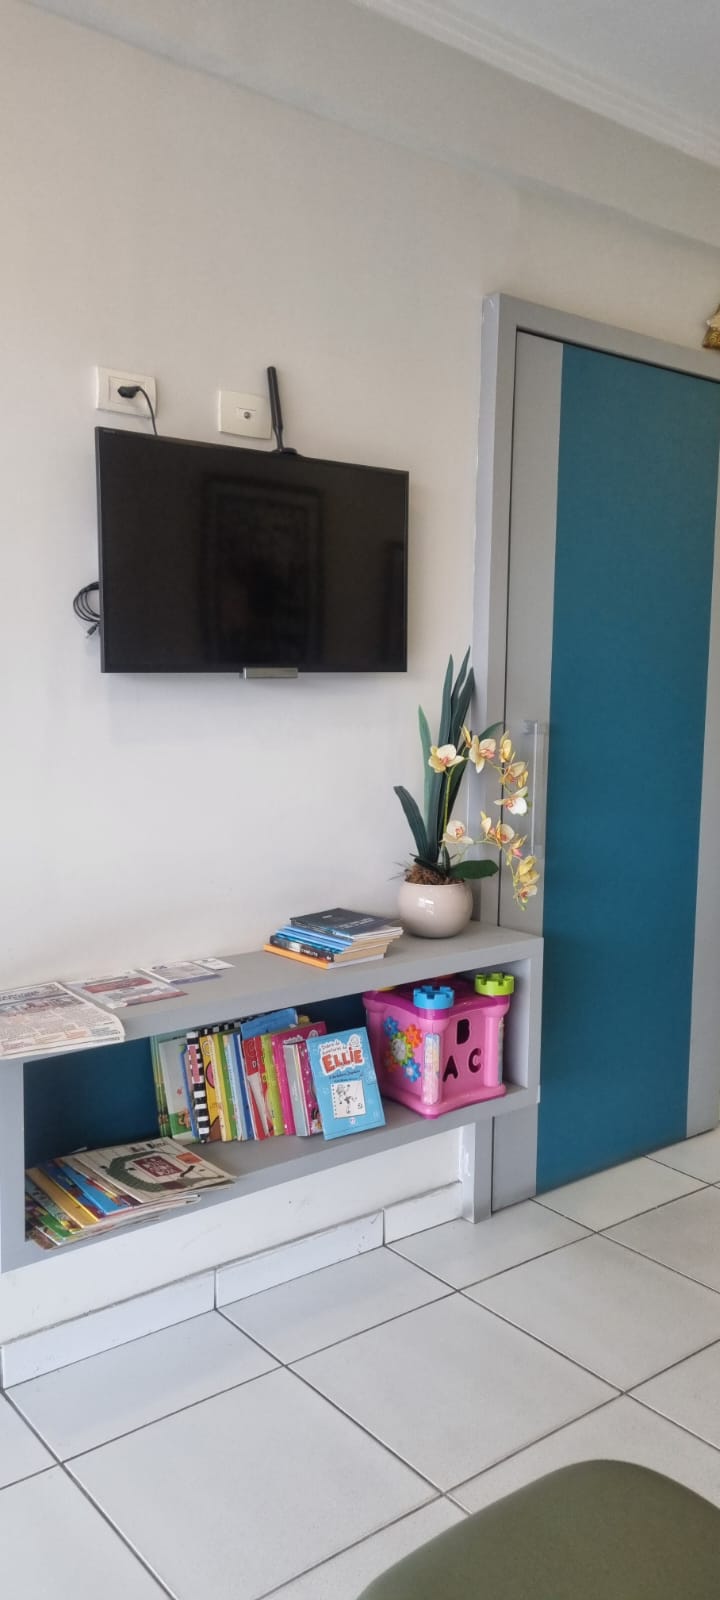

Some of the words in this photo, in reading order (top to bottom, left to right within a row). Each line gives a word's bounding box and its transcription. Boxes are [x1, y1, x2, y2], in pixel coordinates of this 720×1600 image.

[457, 1018, 470, 1044] B
[322, 1046, 363, 1073] ELLIE
[443, 1056, 458, 1082] A
[468, 1048, 482, 1073] C
